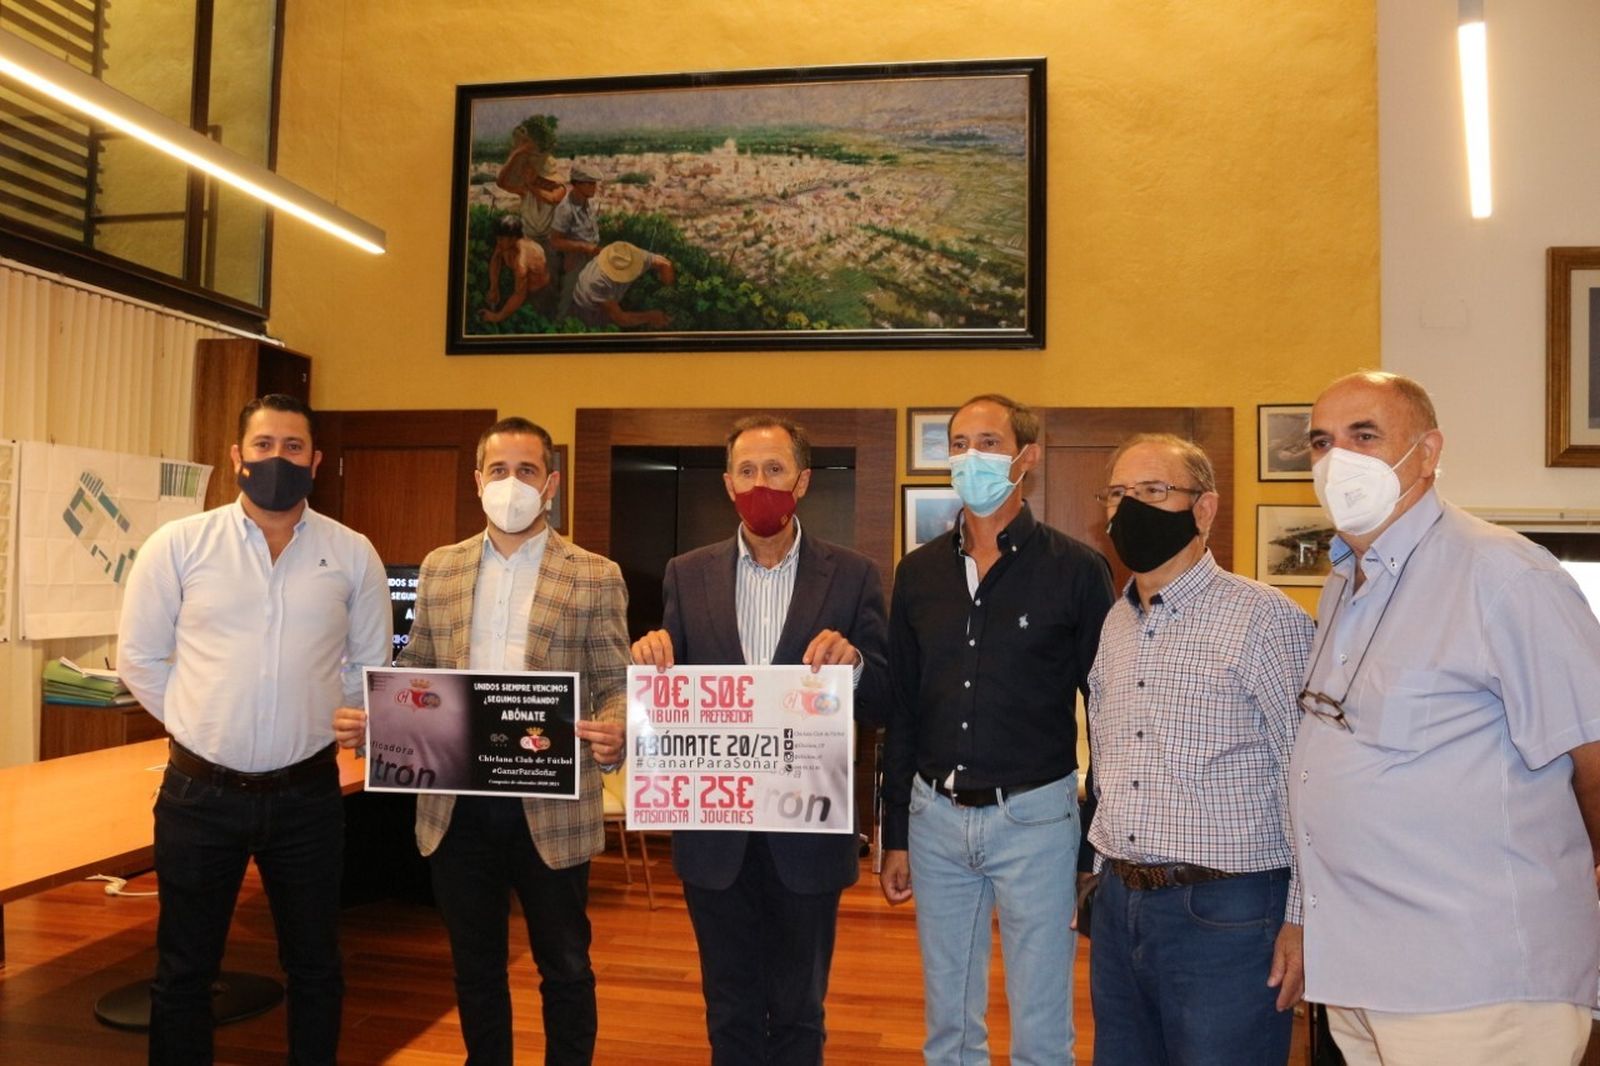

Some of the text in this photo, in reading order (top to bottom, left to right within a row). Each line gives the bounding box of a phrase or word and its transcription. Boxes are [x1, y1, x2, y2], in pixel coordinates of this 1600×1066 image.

[473, 683, 568, 693] UNIDOS SIEMPRE VENCIMOS
[700, 675, 754, 709] 50€
[501, 708, 546, 722] ABÓNATE
[645, 709, 690, 724] IBUNA
[700, 709, 753, 724] PREFERENCIA
[635, 730, 780, 758] ABÓNATE 20/21
[634, 776, 690, 809] 25€
[700, 776, 754, 809] 25€
[634, 809, 690, 824] PENSIONISTA
